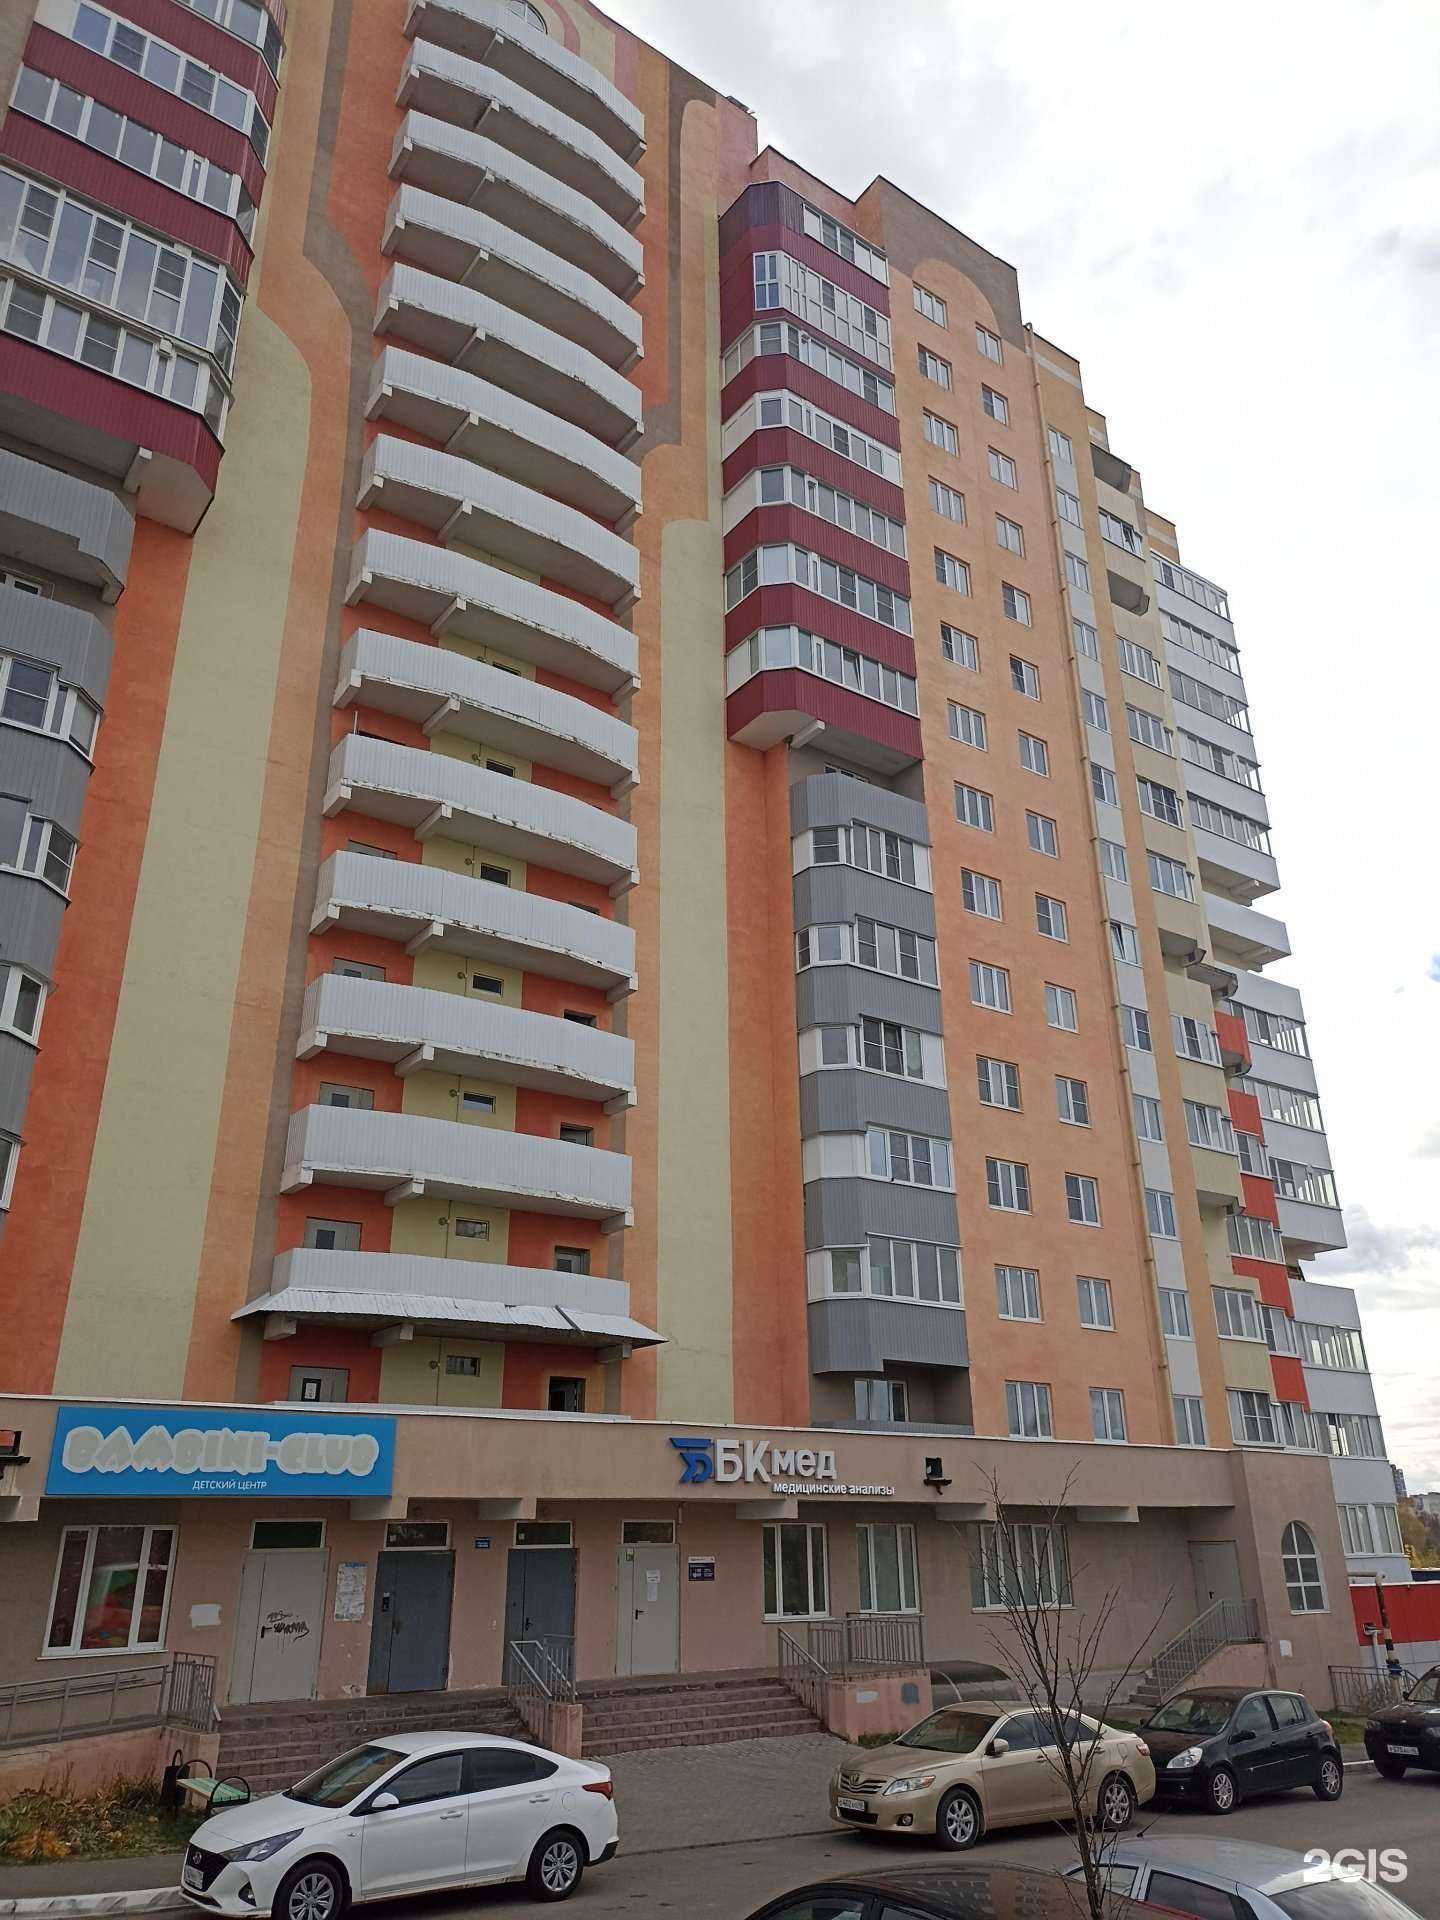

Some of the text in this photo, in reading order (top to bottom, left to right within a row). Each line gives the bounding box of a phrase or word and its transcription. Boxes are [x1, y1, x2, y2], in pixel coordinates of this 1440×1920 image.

[192, 1480, 268, 1491] ДЕТСКИЙ ЦЕНТР
[772, 1482, 896, 1496] медицинские анализы
